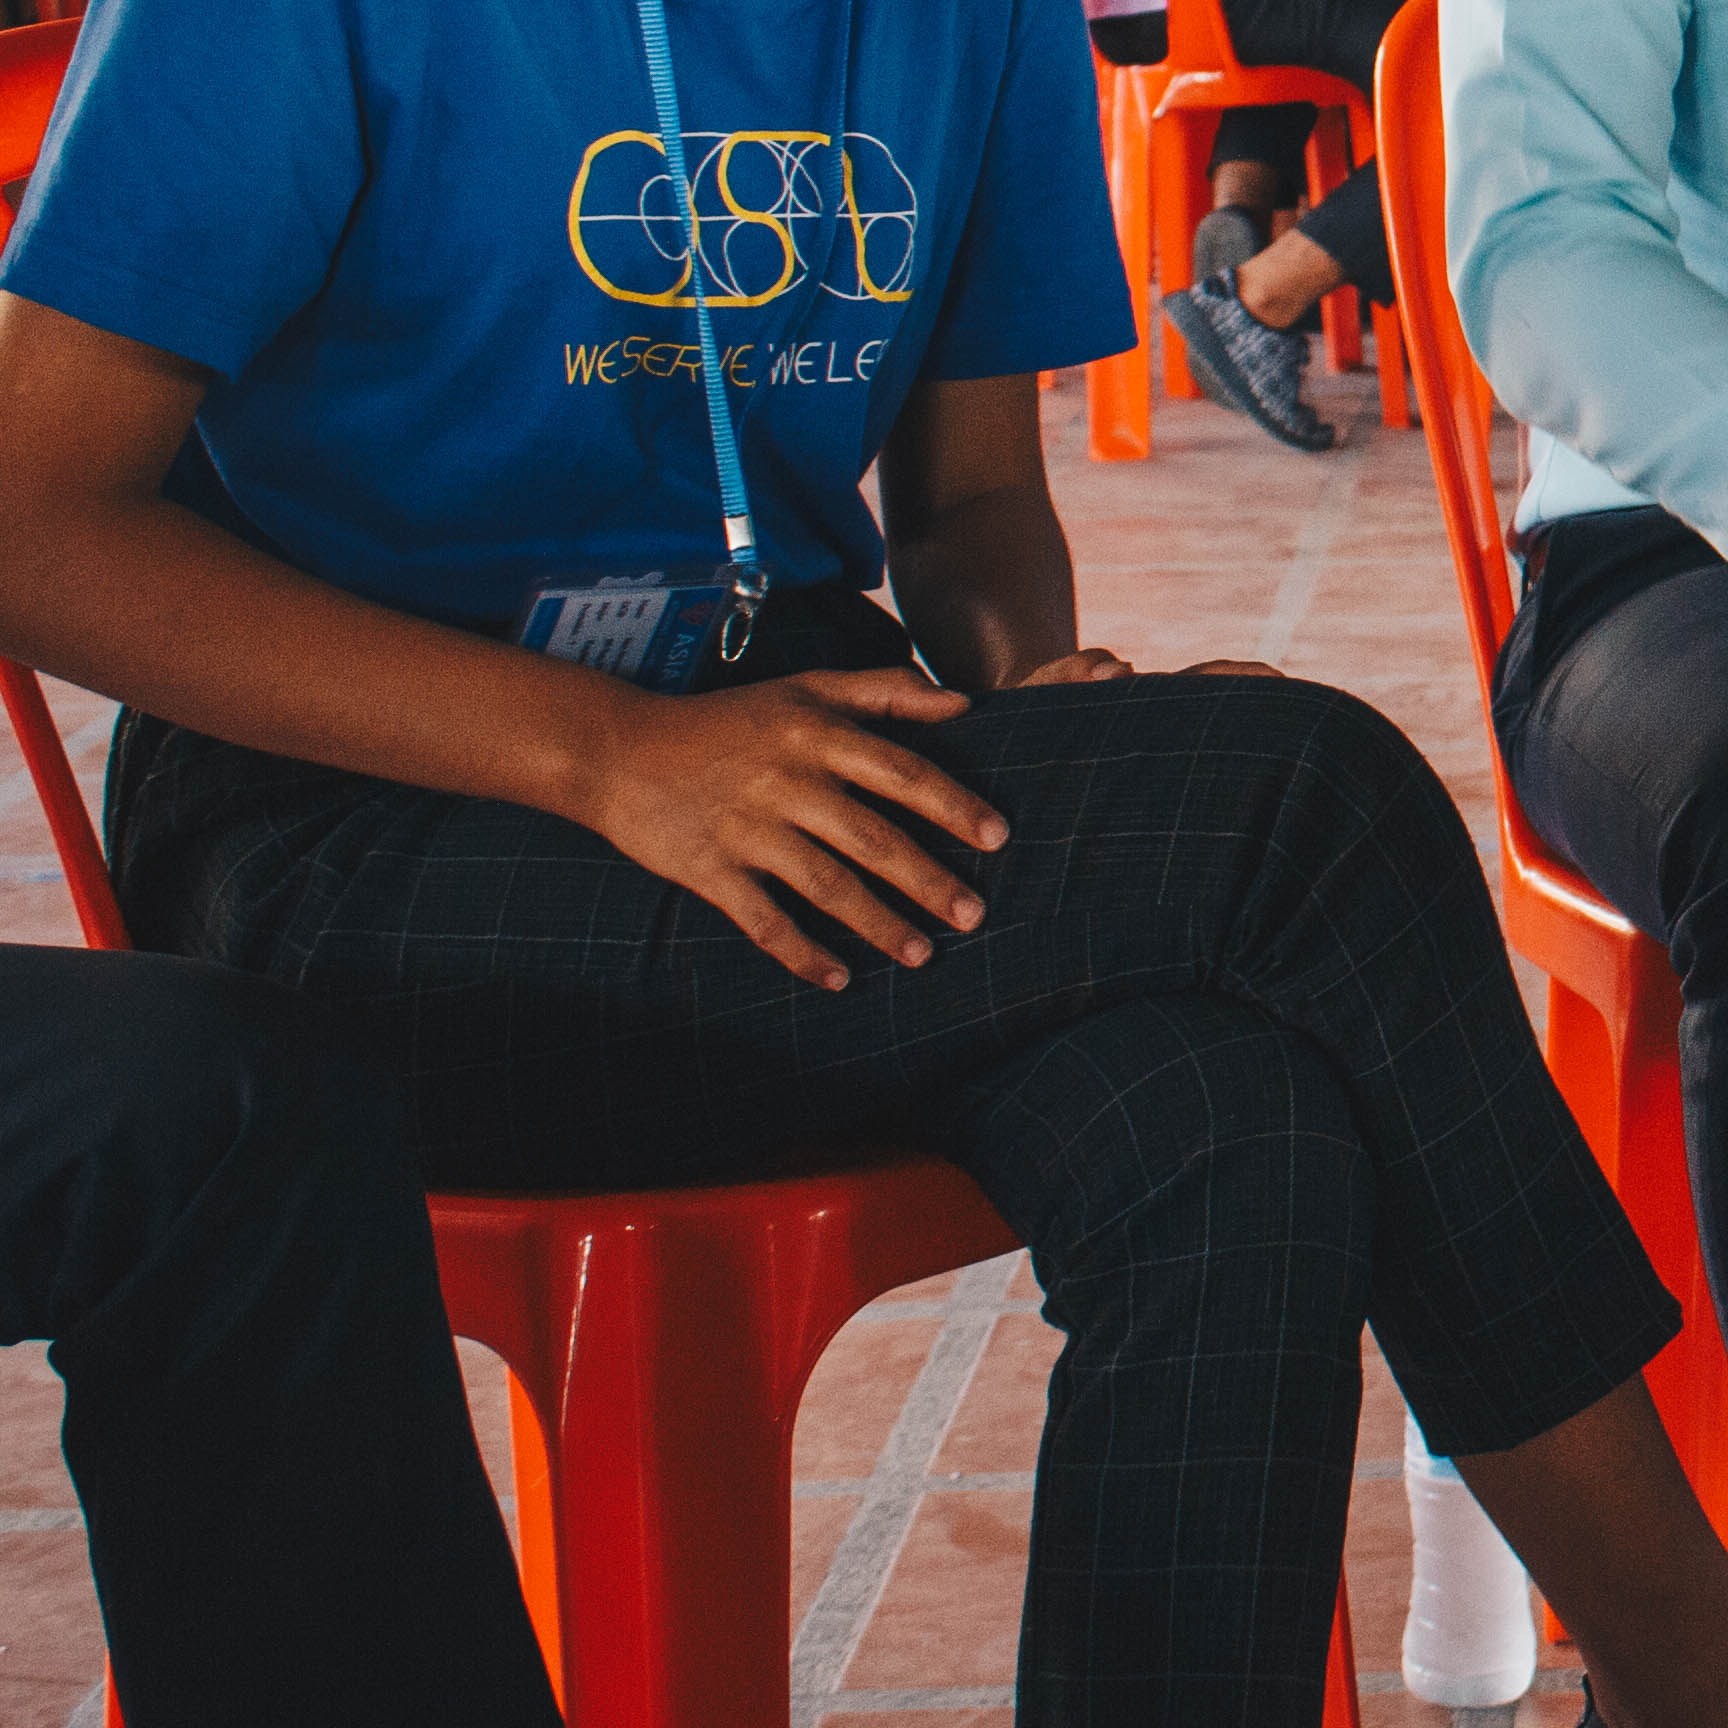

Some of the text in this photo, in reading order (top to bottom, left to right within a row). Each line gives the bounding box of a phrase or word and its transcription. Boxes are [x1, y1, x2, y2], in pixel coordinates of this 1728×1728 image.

[565, 340, 620, 385] WE
[768, 342, 823, 385] WE
[826, 339, 889, 384] LE
